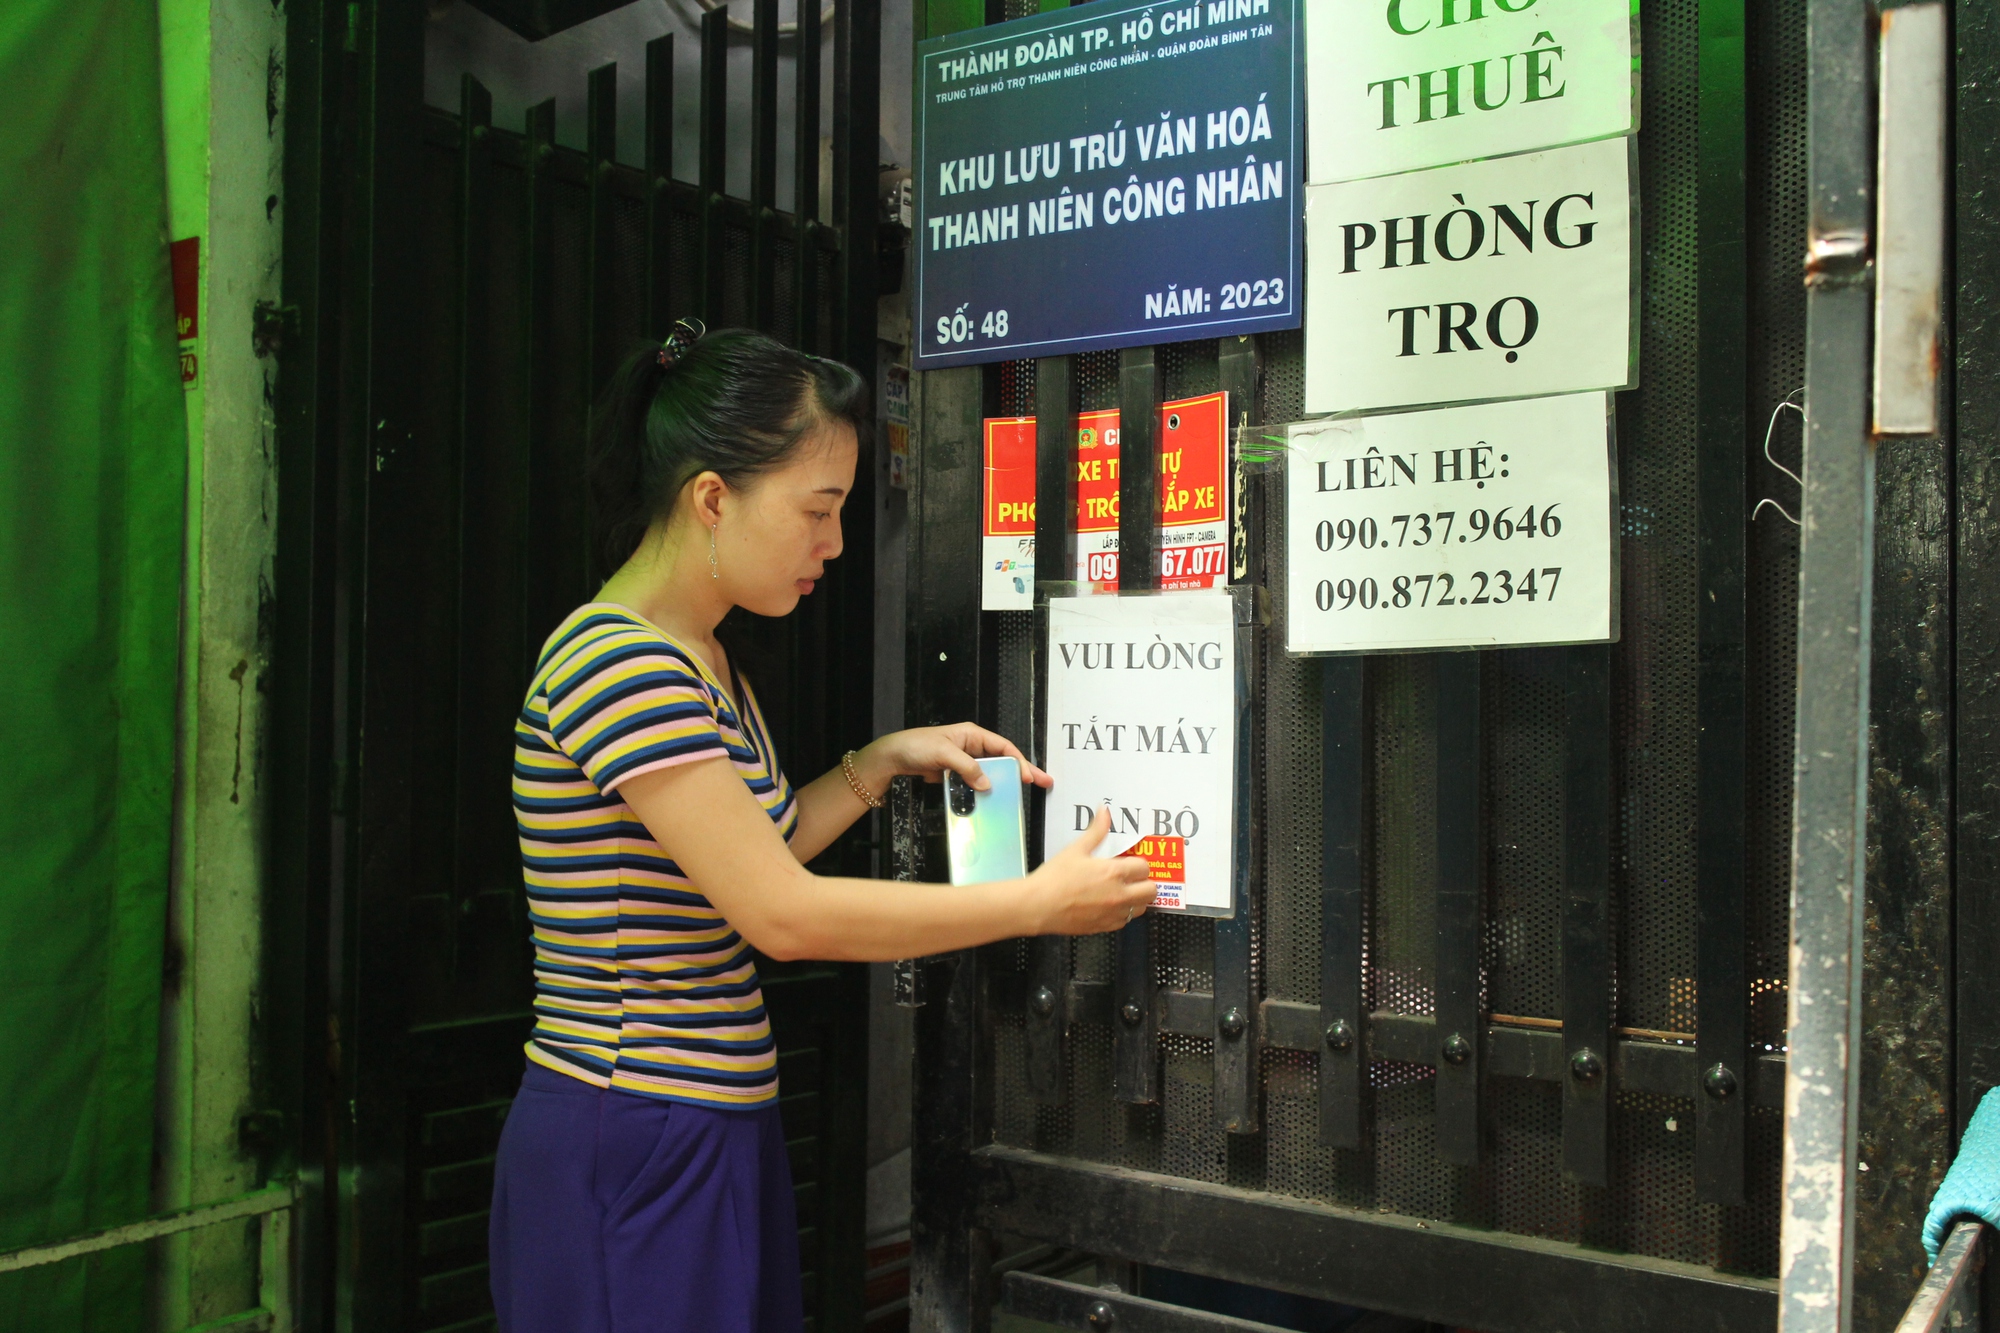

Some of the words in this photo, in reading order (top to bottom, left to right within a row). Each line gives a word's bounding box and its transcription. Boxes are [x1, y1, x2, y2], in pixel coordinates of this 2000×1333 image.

[939, 50, 1009, 83] THÀNH
[1015, 32, 1074, 67] ĐOÀN
[1081, 27, 1114, 53] TP.
[1121, 8, 1154, 45] HỒ
[1160, 0, 1201, 36] CHÍ
[1207, 0, 1270, 26] MINH
[1386, 0, 1540, 36] CH
[936, 89, 967, 104] TRUNG
[969, 82, 989, 98] TÂM
[1006, 76, 1027, 91] TRỢ
[1029, 68, 1062, 85] THANH
[1064, 61, 1088, 79] NIÊN
[1089, 54, 1119, 73] CÔNG
[1120, 48, 1149, 68] NHÂN
[1156, 42, 1187, 60] QUẬN
[1189, 35, 1220, 53] ĐOÀN
[1221, 28, 1249, 46] BÌNH
[1250, 23, 1273, 40] TÂN
[1366, 30, 1567, 132] THUÊ
[939, 153, 996, 197] KHU
[1004, 141, 1061, 186] LƯU
[1070, 120, 1127, 173] TRÚ
[1136, 111, 1197, 162] VĂN
[1206, 92, 1273, 150] HOÁ
[928, 204, 1019, 251] THANH
[1028, 186, 1094, 237] NIÊN
[1102, 175, 1186, 226] CÔNG
[1196, 154, 1284, 211] NHÂN
[1338, 191, 1599, 275] PHÒNG
[1145, 284, 1211, 319] NĂM:
[1220, 278, 1285, 311] 2023
[936, 303, 975, 345] SỐ:
[980, 309, 1009, 339] 48
[1387, 296, 1540, 364] TRỌ
[887, 399, 909, 418] CAME
[1078, 461, 1102, 482] XE
[1315, 446, 1418, 493] LIÊN
[1432, 441, 1510, 490] HỆ:
[1086, 492, 1120, 520] TRỘ
[1162, 481, 1190, 514] ẮP
[1194, 486, 1215, 509] XE
[1315, 503, 1563, 553] 090.737.9646
[1315, 567, 1563, 612] 090.872.2347
[1058, 643, 1116, 670] VUI
[1124, 634, 1224, 671] LÒNG
[1061, 715, 1127, 751] TẮT
[1135, 717, 1218, 755] MÁY
[1072, 797, 1142, 835] DẪN
[1152, 805, 1200, 846] BỘ
